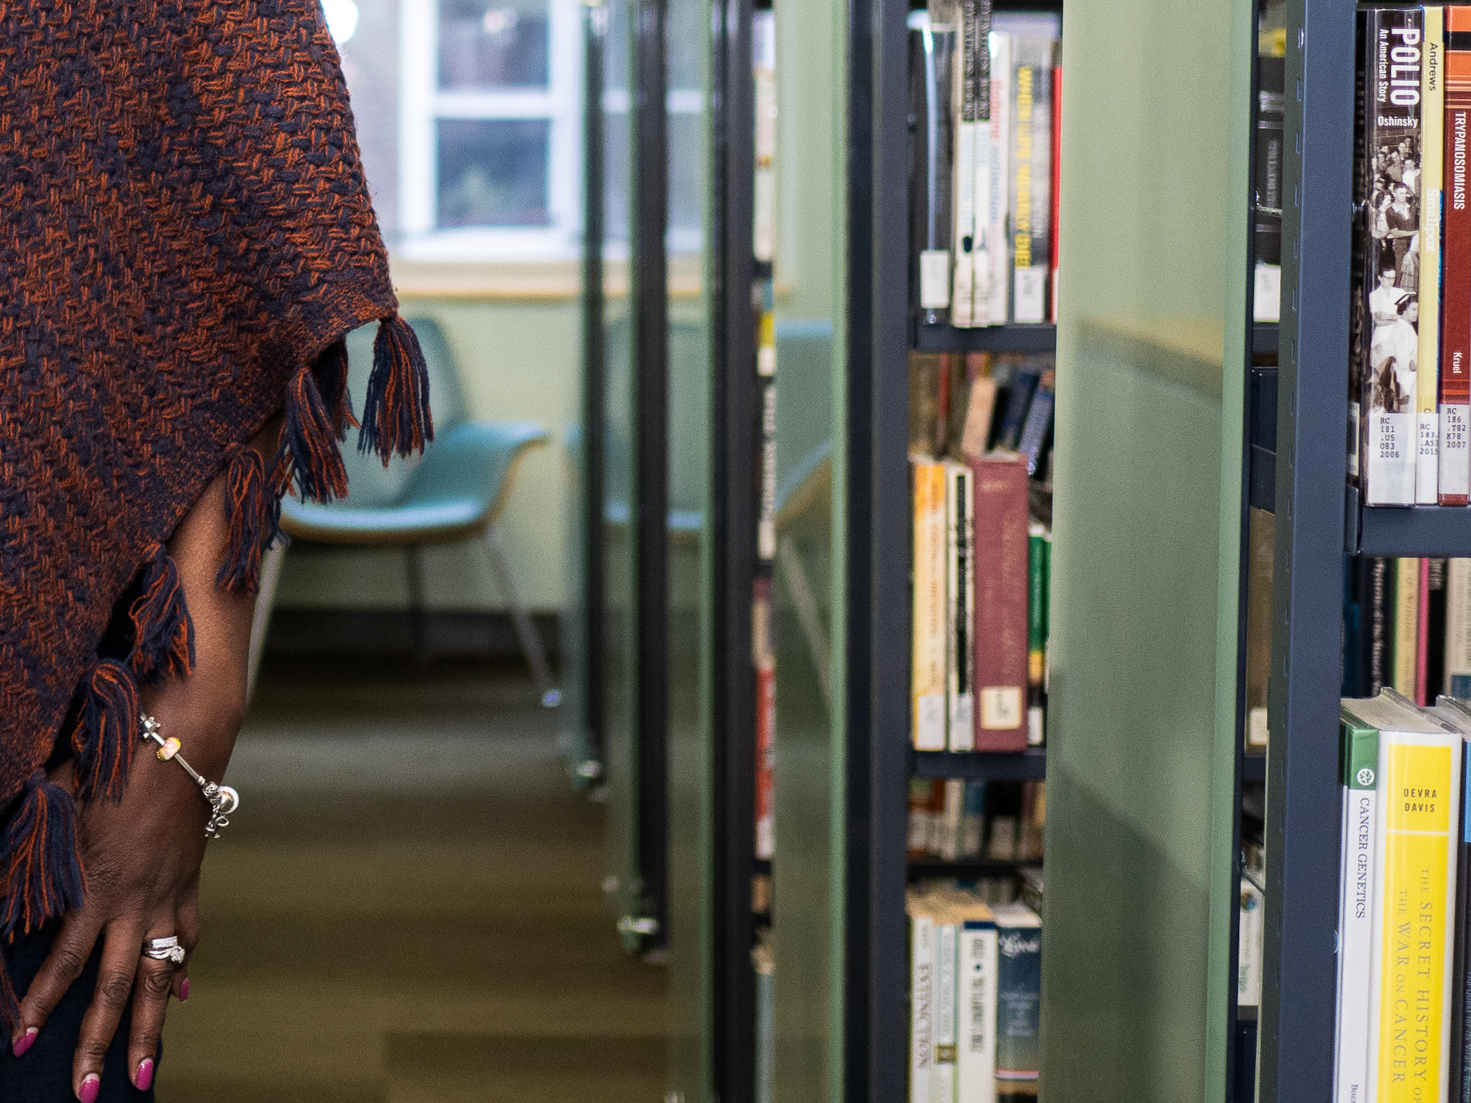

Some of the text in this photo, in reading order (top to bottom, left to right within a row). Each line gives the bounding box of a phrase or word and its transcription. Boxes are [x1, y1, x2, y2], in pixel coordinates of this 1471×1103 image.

[1377, 29, 1389, 103] An American Story
[1390, 28, 1421, 106] POLIO
[1428, 42, 1439, 92] Andrews
[1016, 66, 1033, 120] WHEN
[1377, 116, 1419, 128] Oshinsky
[1453, 111, 1467, 210] TRYPANOSOMIASIS
[1015, 164, 1031, 231] NEARLY
[1423, 188, 1440, 253] Smallpox
[1452, 352, 1463, 374] Kruel
[1380, 425, 1395, 433] 181
[1447, 407, 1457, 415] RC
[1447, 415, 1462, 423] 186
[1380, 450, 1400, 458] 2006
[1446, 440, 1467, 449] 2007
[1403, 788, 1438, 799] DEVRA
[1404, 802, 1436, 813] DAVIS
[1355, 797, 1371, 919] CANCER GENETICS
[1420, 867, 1430, 894] THE
[1417, 901, 1433, 979] SECRET
[1392, 889, 1411, 1083] THE WAR ON CANCER
[1413, 989, 1429, 1082] HISTORY
